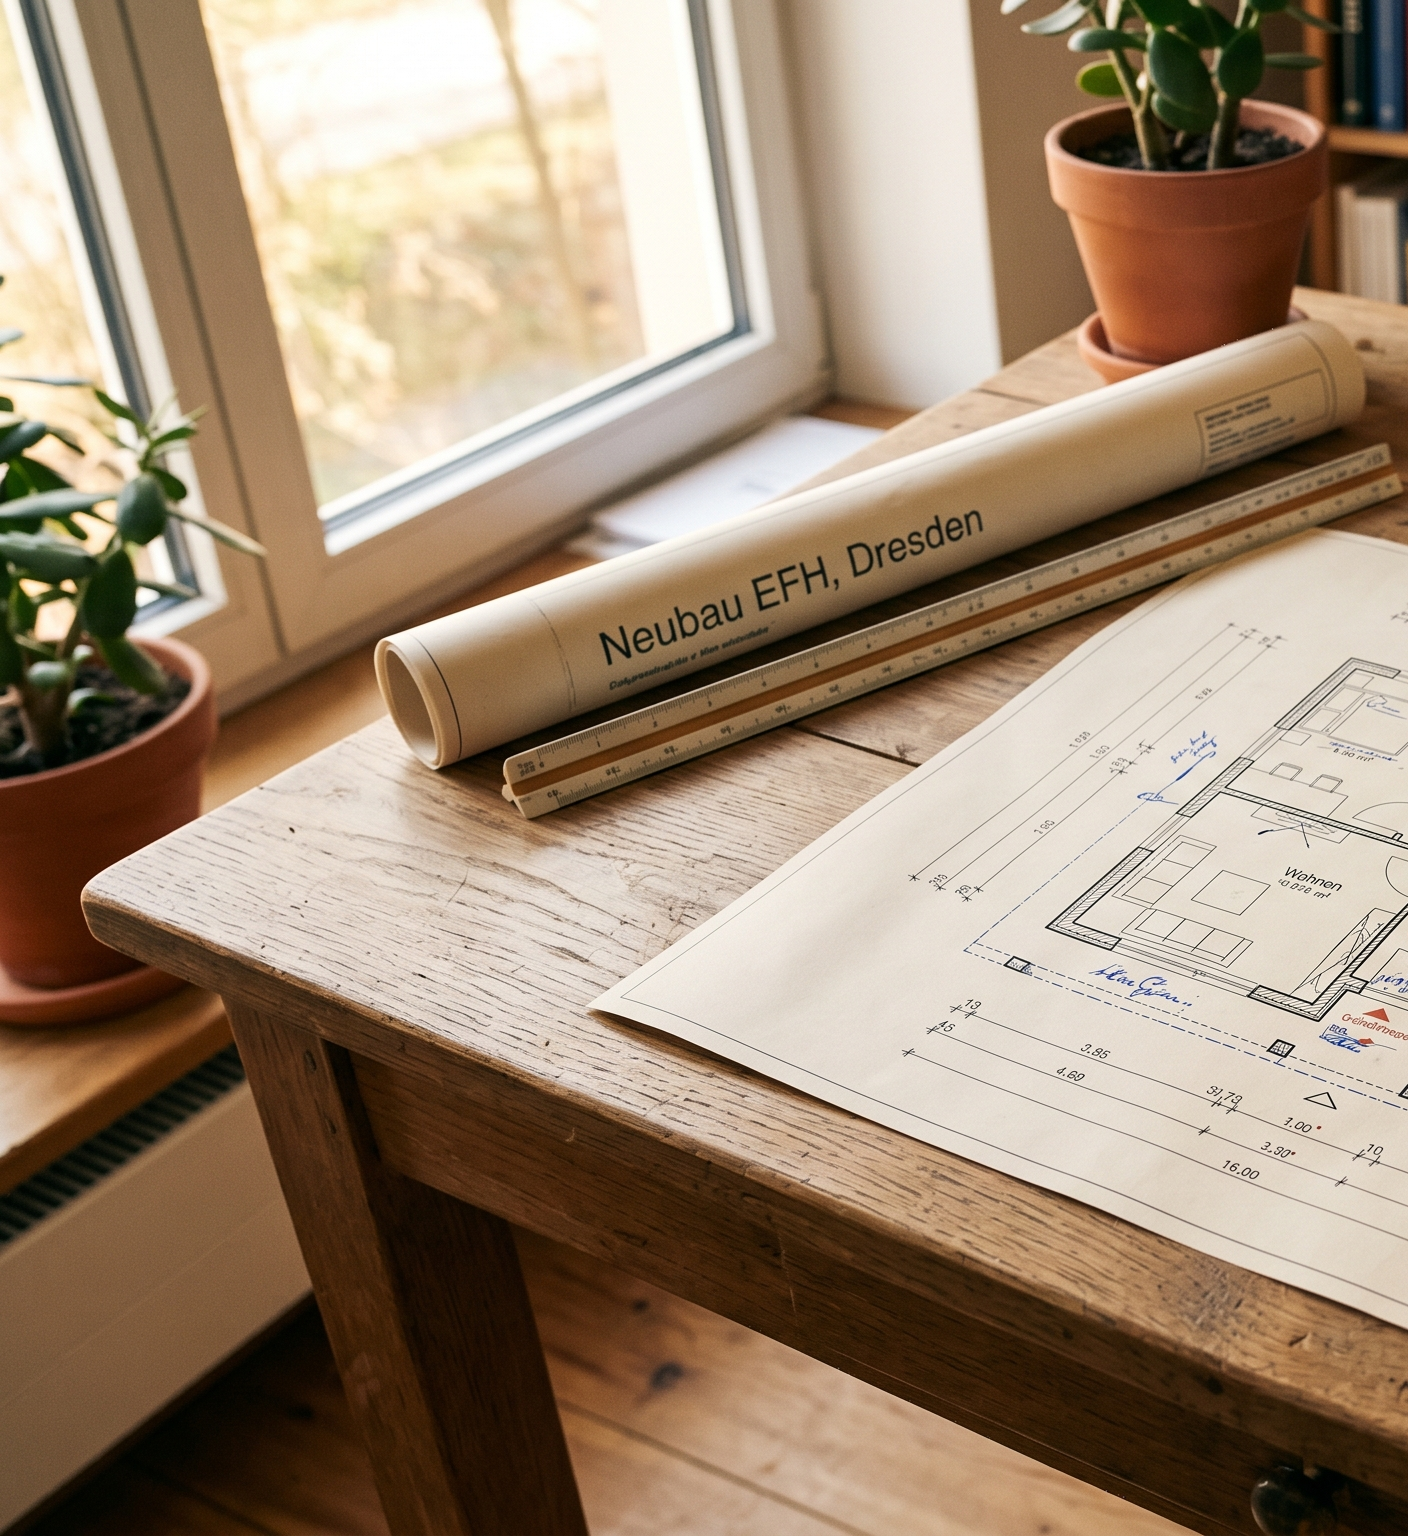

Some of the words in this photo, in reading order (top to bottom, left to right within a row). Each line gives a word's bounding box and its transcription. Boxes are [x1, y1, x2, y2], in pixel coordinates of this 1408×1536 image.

[599, 594, 744, 665] Neubau
[751, 555, 840, 612] EFH,
[846, 509, 984, 577] Dresden
[1222, 1159, 1260, 1180] 16.00
